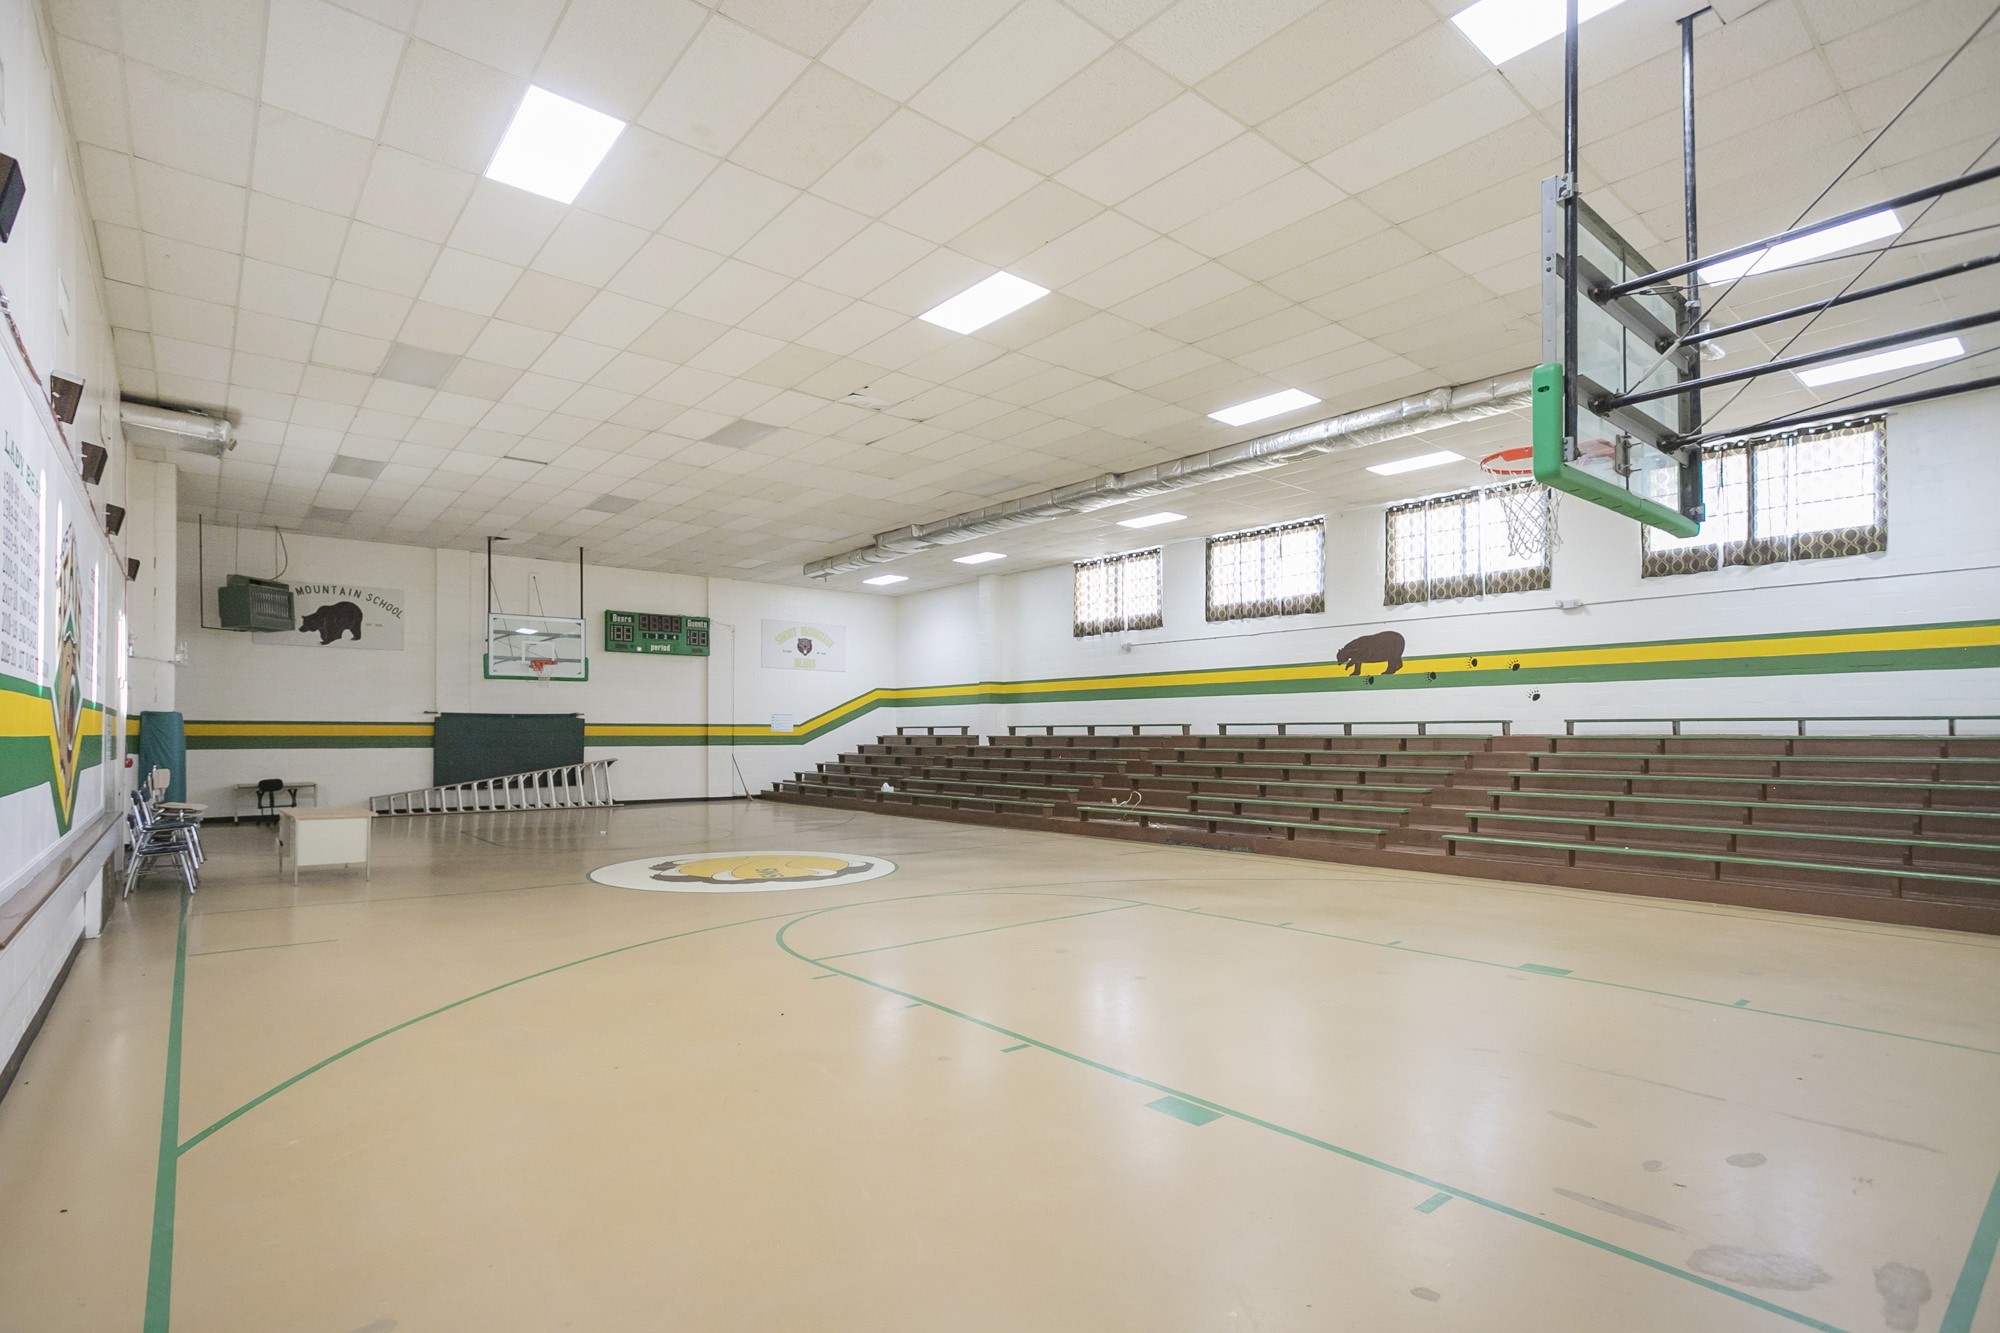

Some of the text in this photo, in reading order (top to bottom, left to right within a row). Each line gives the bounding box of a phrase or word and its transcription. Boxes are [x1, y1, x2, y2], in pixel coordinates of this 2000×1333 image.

[4, 430, 24, 475] LADY
[295, 585, 405, 620] MOUNTAIN SCHOOL
[612, 613, 632, 623] Bears
[650, 644, 671, 652] period
